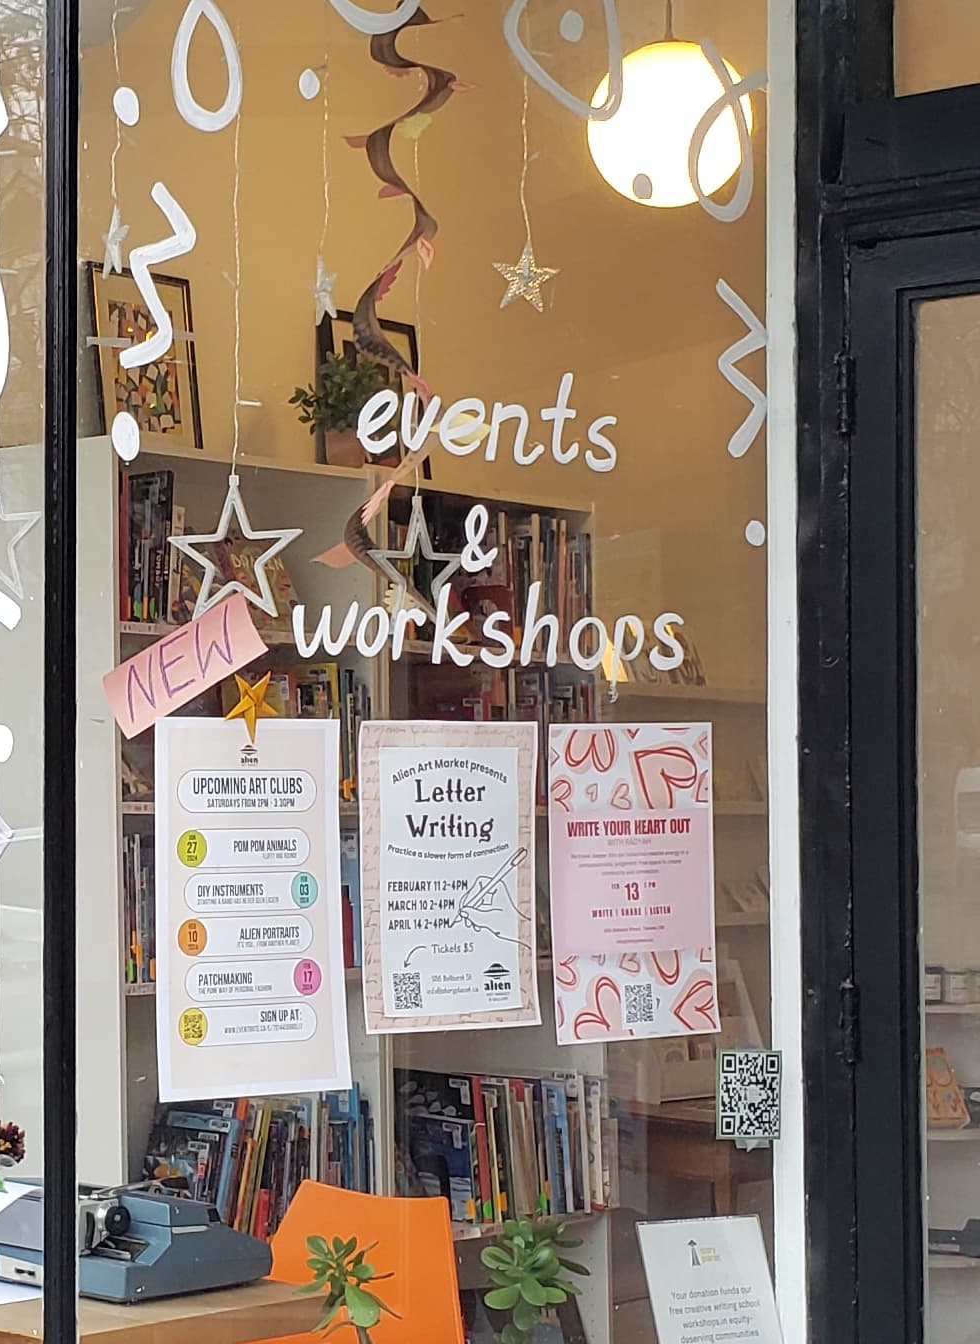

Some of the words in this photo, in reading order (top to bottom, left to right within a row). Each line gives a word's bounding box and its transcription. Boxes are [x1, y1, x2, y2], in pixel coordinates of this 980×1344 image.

[356, 372, 618, 472] events
[460, 504, 498, 573] &
[292, 581, 684, 684] workshops
[126, 603, 233, 723] NEW
[391, 765, 417, 785] Alien
[417, 760, 433, 774] Art
[434, 758, 469, 769] Market
[470, 761, 508, 784] presents
[193, 777, 246, 795] UPCOMING
[249, 777, 267, 794] ART
[270, 777, 303, 794] CLUBS
[414, 778, 486, 803] Letter
[207, 798, 240, 808] SATURDAYS
[241, 798, 256, 808] FROM
[257, 798, 269, 808] 2PM
[405, 813, 495, 844] Writing
[567, 821, 600, 838] WRITE
[603, 820, 631, 836] YOUR
[634, 819, 667, 835] HEART
[670, 818, 691, 834] OUT
[187, 841, 198, 854] 27
[233, 840, 249, 853] POM
[250, 840, 265, 852] POM
[266, 839, 297, 852] ANIMALS
[387, 844, 417, 858] Practice
[424, 850, 446, 860] slower
[447, 850, 465, 860] form
[472, 843, 510, 858] connection
[197, 885, 210, 897] DIY
[212, 884, 264, 897] INSTRUMENTS
[299, 884, 309, 896] 03
[387, 880, 432, 893] FEBRUARY
[434, 881, 441, 892] 11
[442, 879, 468, 892] 2-4PM
[624, 882, 640, 901] 13
[387, 900, 417, 912] MARCH
[419, 900, 428, 911] 10
[429, 899, 455, 911] 2-4PM
[591, 909, 613, 918] WRITE
[649, 906, 671, 915] LISTEN
[388, 919, 412, 931] APRIL
[413, 919, 422, 930] 14
[424, 918, 450, 929] 2-4PM
[188, 930, 198, 943] 10
[239, 928, 261, 940] ALIEN
[263, 926, 300, 939] PORTRAITS
[431, 943, 461, 954] Tickets
[463, 942, 474, 954] $5
[198, 972, 253, 986] PATCHMAKING
[303, 971, 312, 983] 17
[484, 979, 511, 991] alien
[260, 1010, 277, 1023] SIGN
[278, 1009, 289, 1022] UP
[290, 1008, 302, 1021] AT:
[671, 1291, 687, 1300] Your
[688, 1289, 719, 1299] donation
[719, 1286, 740, 1295] funds
[684, 1304, 712, 1314] creative
[714, 1302, 737, 1312] writing
[738, 1299, 760, 1308] school
[682, 1319, 720, 1328] workshops
[680, 1334, 715, 1344] deserving
[715, 1329, 759, 1341] communities
